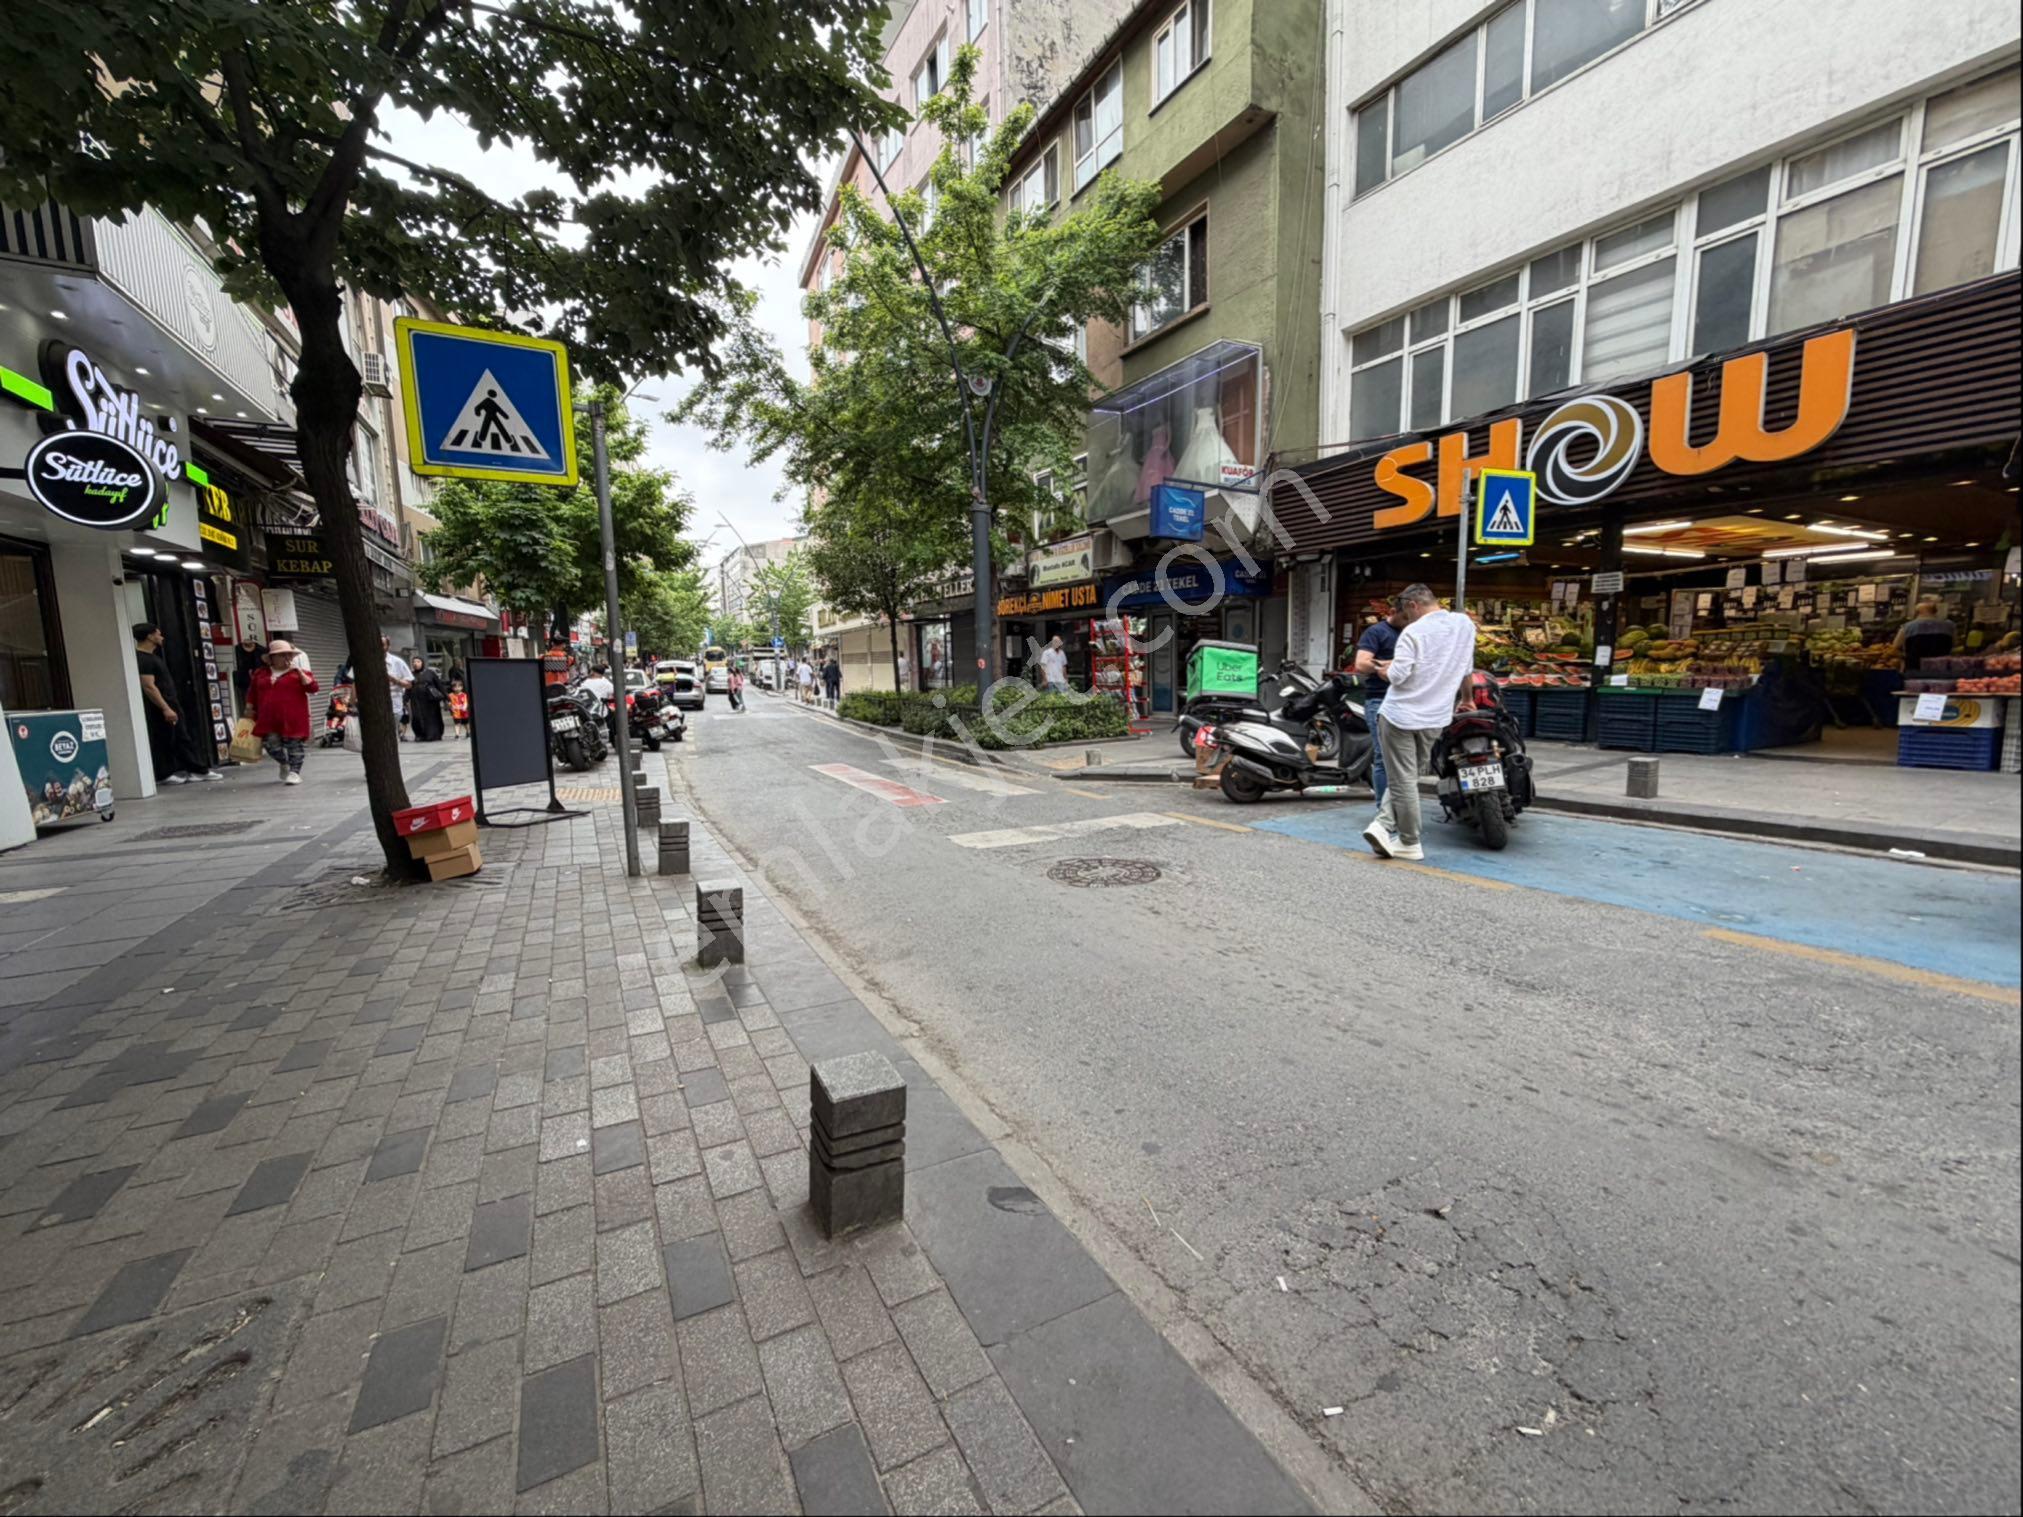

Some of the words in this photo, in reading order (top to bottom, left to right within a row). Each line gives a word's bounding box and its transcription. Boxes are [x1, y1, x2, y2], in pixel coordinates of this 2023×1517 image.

[1373, 328, 1857, 529] SHOW
[41, 451, 143, 488] Sütlüce
[285, 539, 319, 554] SUR
[276, 559, 333, 574] KEBAP
[1071, 584, 1097, 606] USTA
[1216, 661, 1243, 672] Uber
[1216, 671, 1243, 682] Eats
[1460, 768, 1475, 778] 34
[1477, 765, 1500, 776] PLH
[1472, 776, 1496, 788] 828
